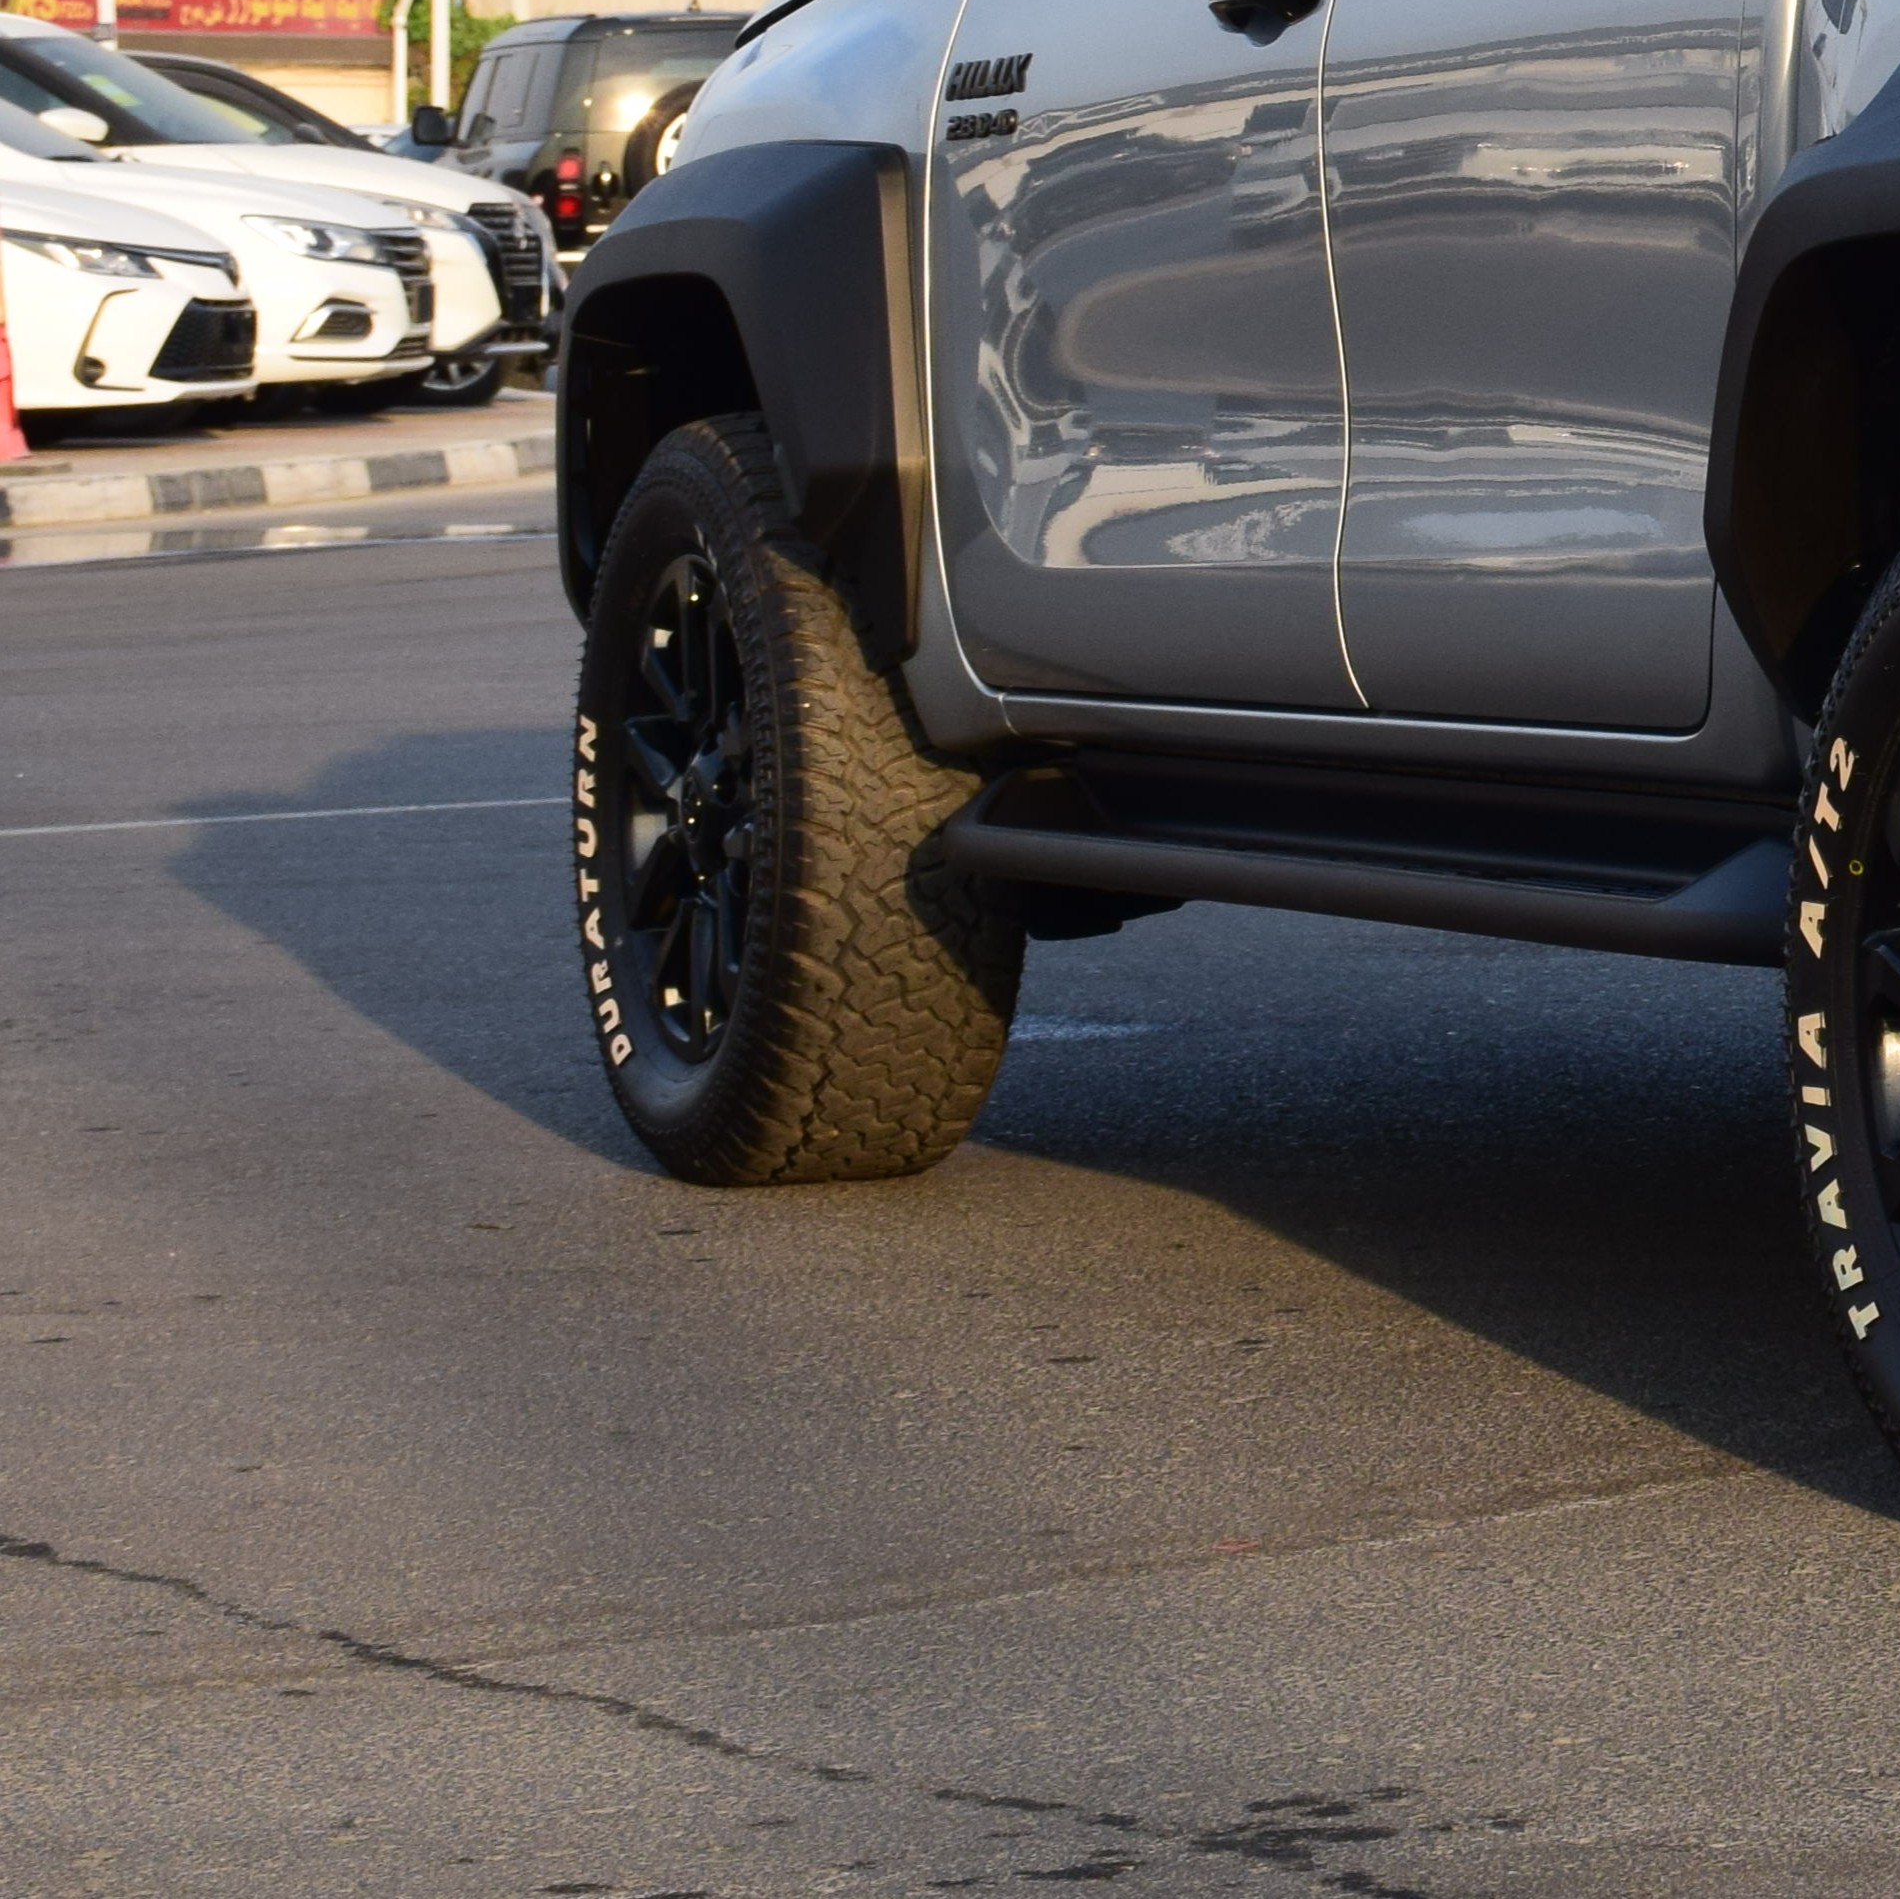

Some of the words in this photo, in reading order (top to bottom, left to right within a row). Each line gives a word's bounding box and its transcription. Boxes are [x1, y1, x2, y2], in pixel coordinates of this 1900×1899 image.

[575, 713, 634, 1067] DURATURN
[1799, 735, 1858, 960] A/T2
[1797, 1011, 1881, 1340] TRAVIA
